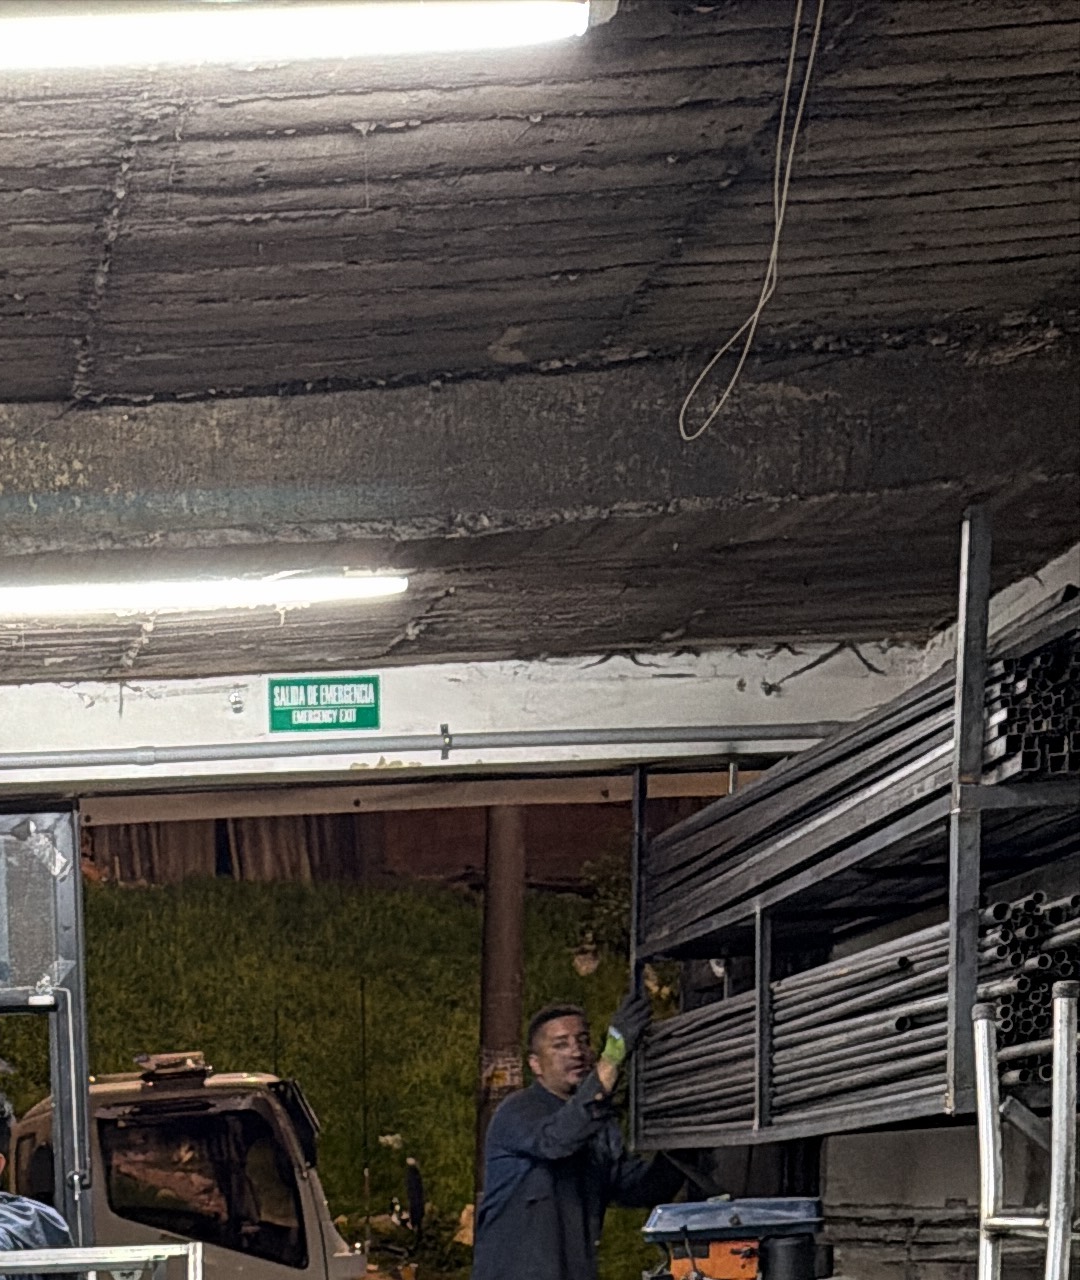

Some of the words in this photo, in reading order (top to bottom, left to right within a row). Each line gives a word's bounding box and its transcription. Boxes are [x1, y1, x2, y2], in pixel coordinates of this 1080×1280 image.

[273, 685, 305, 706] SALIDA
[307, 684, 318, 705] DE
[320, 683, 375, 705] EMERGENCIA
[291, 709, 337, 724] EMERGENCY
[339, 708, 357, 723] EXIT
